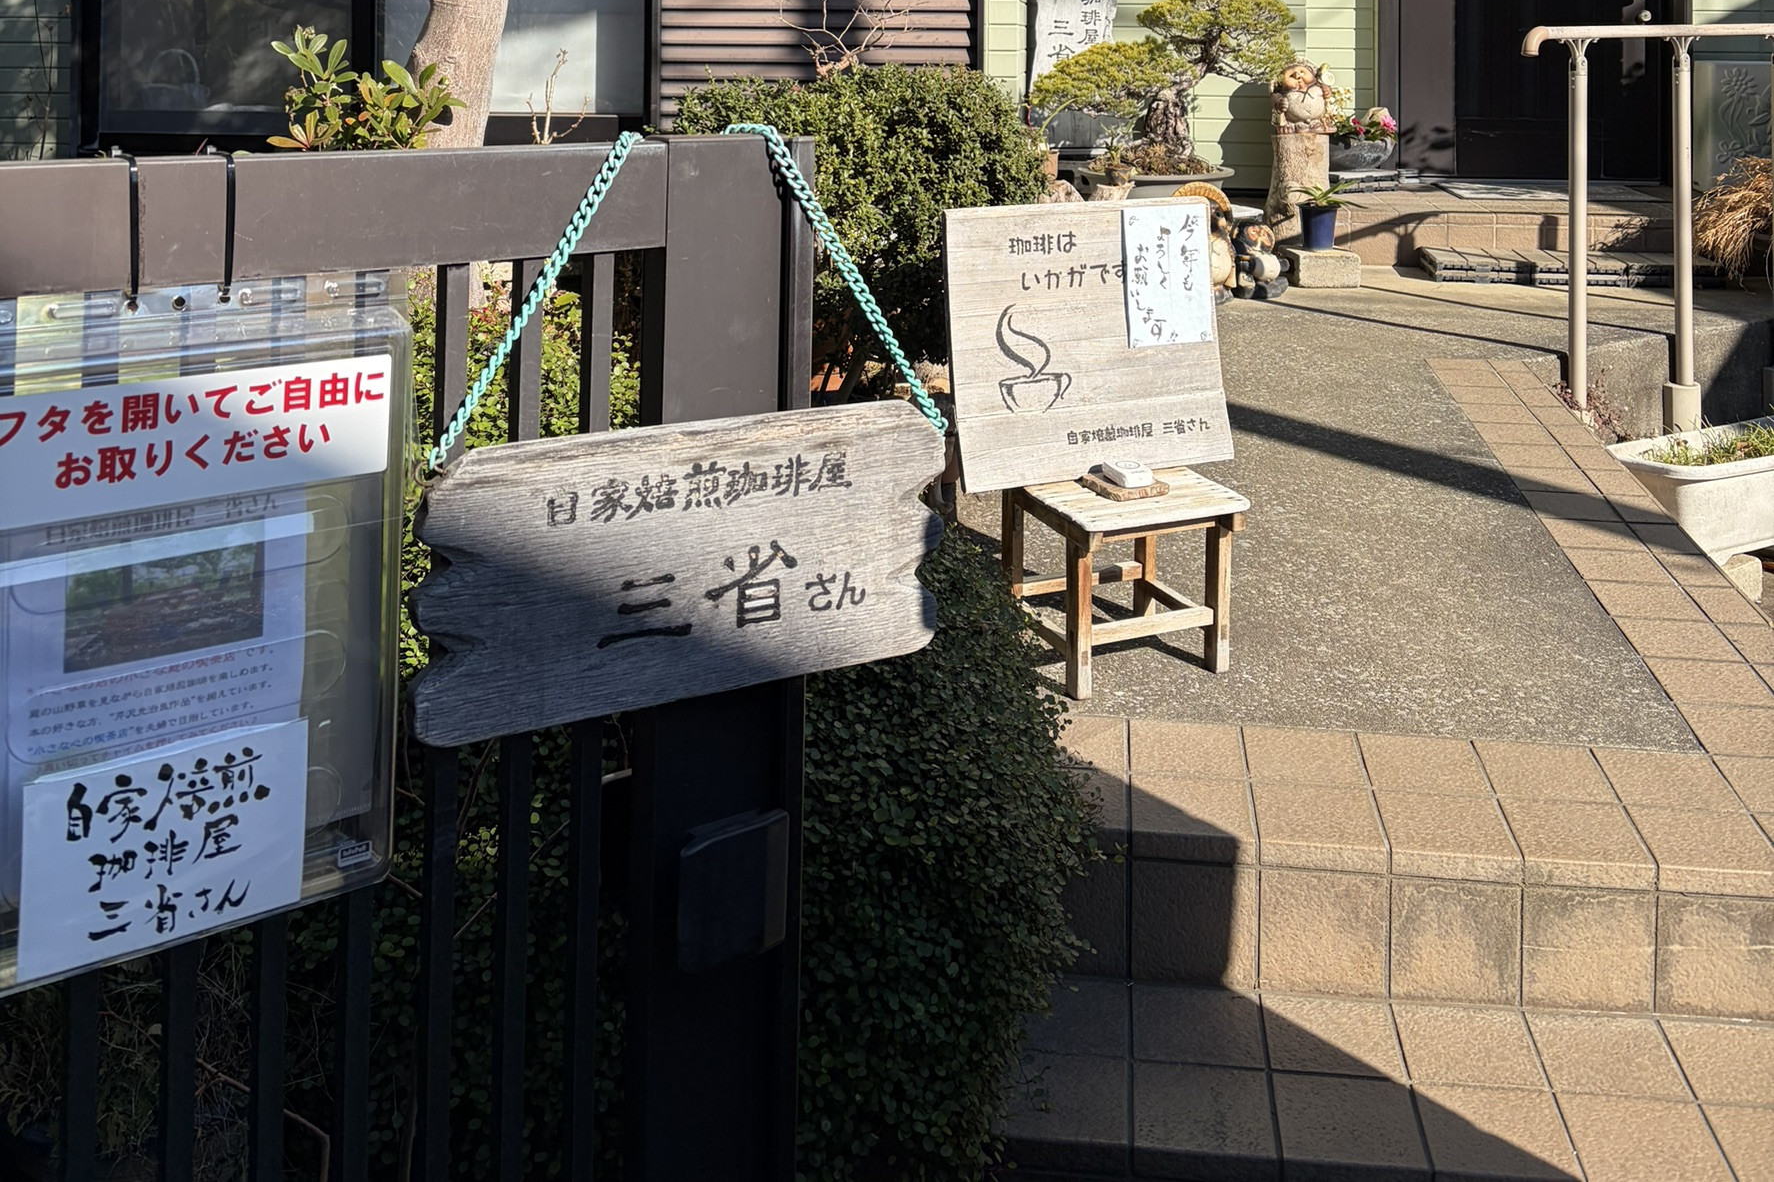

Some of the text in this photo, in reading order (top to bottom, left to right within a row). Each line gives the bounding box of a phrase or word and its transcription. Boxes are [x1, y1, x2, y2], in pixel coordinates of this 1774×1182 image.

[1008, 230, 1077, 255] 珈琲は
[1155, 225, 1171, 290] よろしく
[1179, 214, 1199, 292] 今年も
[0, 371, 385, 447] フタを開いてご自由に
[1066, 418, 1211, 445] 自家焙煎珈琲屋 三省さん
[54, 423, 331, 490] お取りください
[546, 452, 853, 527] 自家焙煎珈琲屋
[597, 539, 866, 649] 三省さん
[66, 747, 270, 842] 自家焙煎
[88, 814, 243, 893] 珈琲屋
[87, 879, 252, 941] 三省さん
